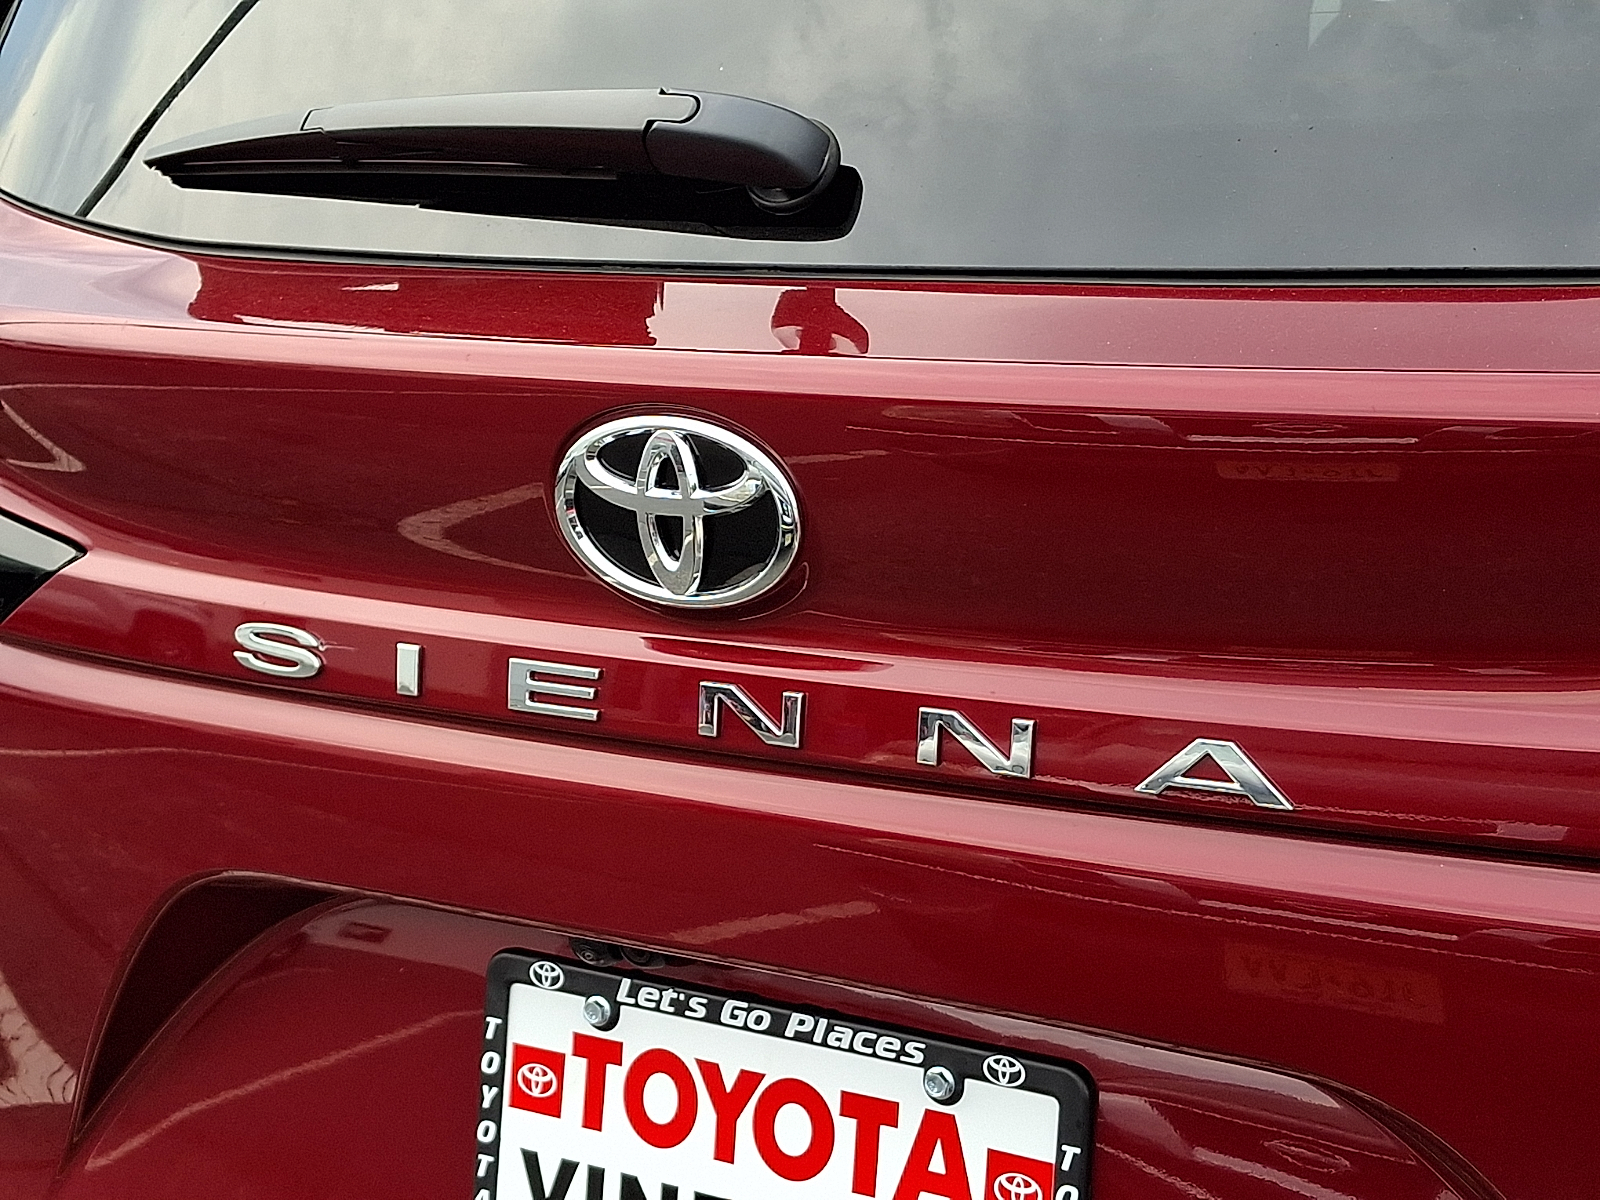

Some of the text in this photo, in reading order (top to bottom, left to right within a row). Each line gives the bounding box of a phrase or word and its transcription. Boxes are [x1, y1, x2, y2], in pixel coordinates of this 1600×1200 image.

[232, 621, 1295, 811] SIENNA
[616, 977, 927, 1064] Let's Go Places
[571, 1030, 973, 1200] TOYOTA
